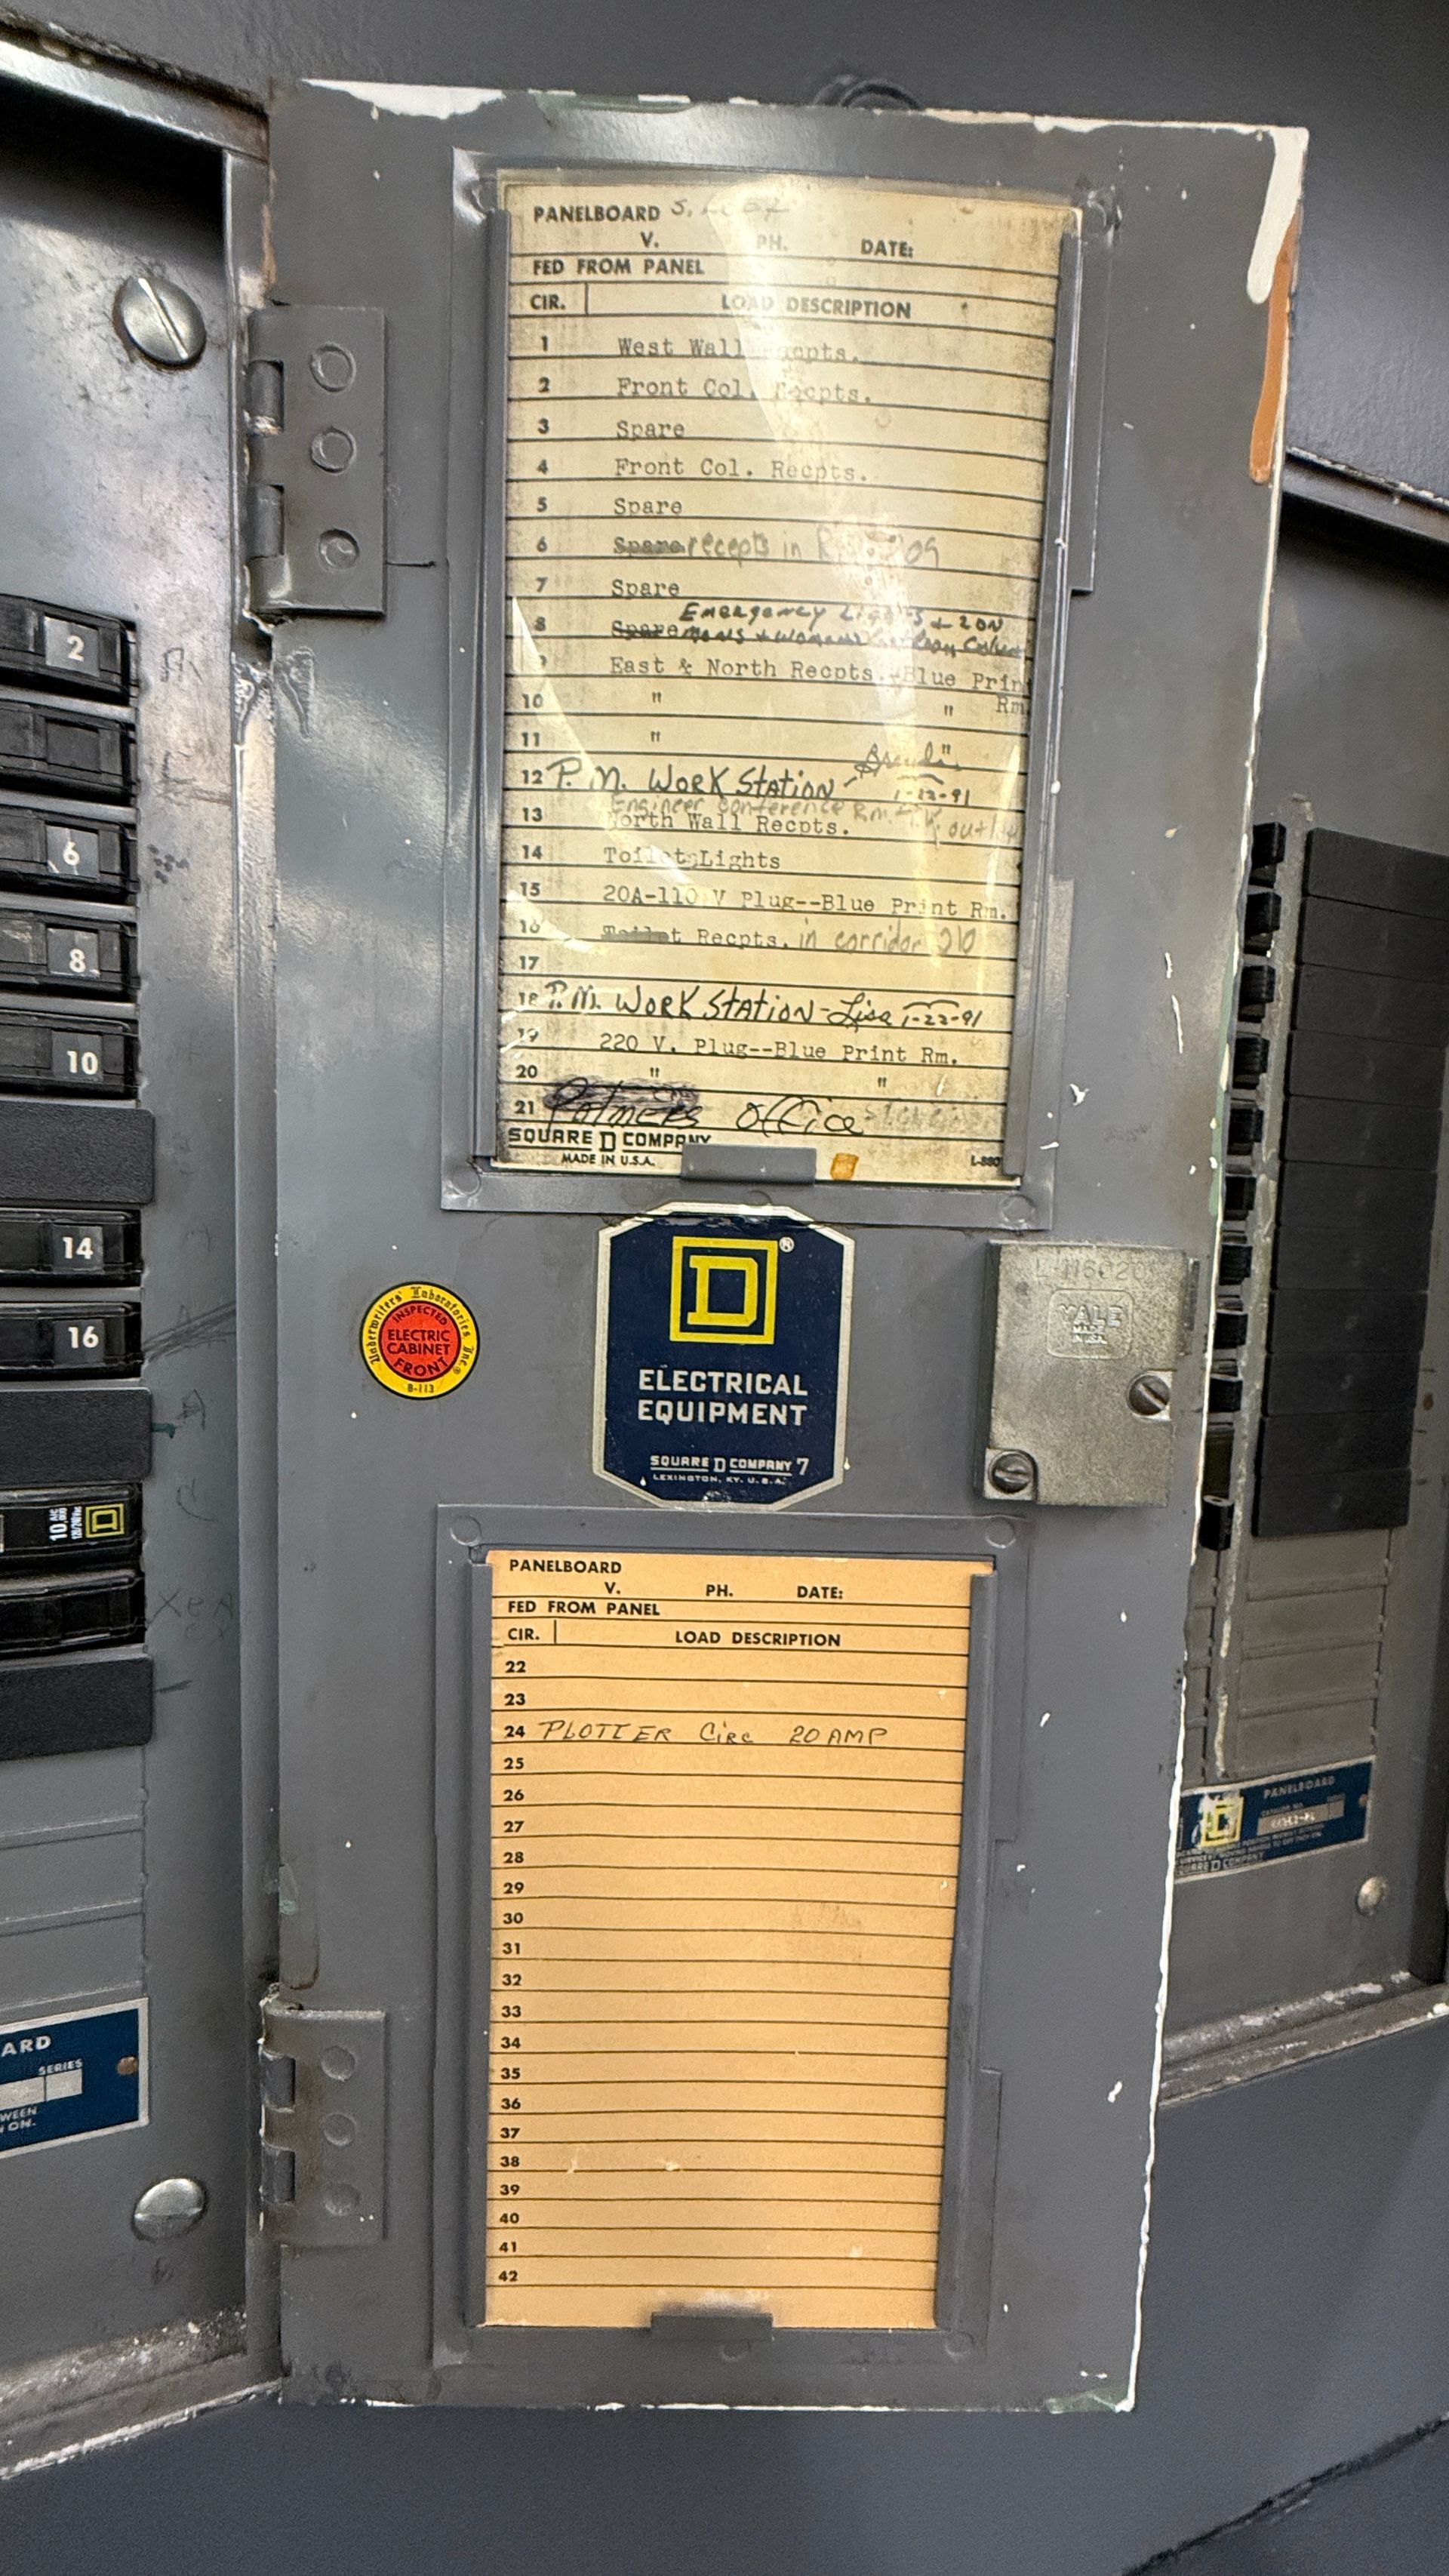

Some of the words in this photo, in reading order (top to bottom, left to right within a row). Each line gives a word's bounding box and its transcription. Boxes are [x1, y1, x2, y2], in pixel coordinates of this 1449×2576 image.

[534, 205, 660, 222] PANELBOARD
[641, 232, 659, 248] V.
[756, 234, 788, 251] PH.
[861, 239, 913, 258] DATE:
[534, 260, 564, 275] FED
[577, 258, 631, 274] FROM
[644, 258, 704, 275] PANEL
[530, 294, 565, 309] CIR.
[721, 294, 774, 310] LOAD
[786, 297, 911, 319] DESCRIPTION
[540, 336, 548, 351] 1
[618, 337, 673, 355] West
[689, 337, 742, 355] Wall
[538, 377, 550, 393] 2
[617, 377, 688, 397] Front
[703, 378, 755, 399] Col.
[538, 419, 549, 434] 3
[617, 420, 685, 441] Spare
[537, 460, 549, 475] 4
[615, 458, 684, 477] Front
[700, 458, 753, 478] Col.
[771, 460, 867, 484] Recpts.
[537, 497, 548, 512] 5
[614, 497, 682, 516] Spare
[537, 537, 547, 552] 6
[536, 577, 548, 593] 7
[612, 579, 681, 598] Spare
[534, 617, 546, 632] 8
[67, 636, 84, 661] 2
[611, 656, 664, 675] East
[680, 657, 692, 675] &
[707, 658, 777, 677] North
[522, 693, 543, 708] 10
[522, 732, 540, 746] 11
[522, 770, 543, 783] 12
[522, 808, 543, 822] 13
[688, 811, 742, 831] Wall
[757, 817, 848, 836] Recpts.
[63, 840, 79, 866] 6
[522, 845, 542, 860] 14
[699, 849, 780, 870] Lights
[521, 882, 540, 897] 15
[891, 897, 958, 916] Print
[971, 901, 1007, 920] Rm.
[697, 929, 788, 949] Recpts.
[69, 948, 86, 973] 8
[519, 956, 539, 970] 17
[601, 1033, 638, 1051] 220
[654, 1035, 675, 1053] V.
[843, 1045, 906, 1063] Print
[921, 1046, 958, 1065] Rm.
[68, 1051, 98, 1076] 10
[515, 1066, 537, 1079] 20
[515, 1101, 534, 1115] 21
[509, 1128, 592, 1144] SQUARE
[600, 1132, 616, 1153] D
[561, 1153, 595, 1165] MADE
[601, 1155, 614, 1165] IN
[620, 1156, 656, 1166] U.S.A.
[63, 1237, 94, 1259] 14
[392, 1305, 448, 1326] INSPECTED
[68, 1326, 99, 1349] 16
[387, 1329, 451, 1341] ELECTRIC
[386, 1343, 451, 1355] CABINET
[393, 1357, 449, 1377] FRONT
[639, 1368, 808, 1396] ELECTRICAL
[637, 1399, 808, 1426] EQUIPMENT
[650, 1454, 709, 1468] SQUARE
[714, 1457, 726, 1473] D
[730, 1457, 792, 1471] COMPANY
[796, 1457, 809, 1476] 7
[653, 1473, 721, 1484] LEXINGTON,
[509, 1559, 622, 1574] PANELBOARD
[605, 1581, 621, 1594] V.
[706, 1584, 734, 1597] PH.
[797, 1586, 844, 1599] DATE:
[508, 1601, 536, 1614] FED
[548, 1601, 595, 1614] FROM
[607, 1602, 660, 1616] PANEL
[508, 1627, 540, 1640] CIR.
[675, 1630, 721, 1644] LOAD
[732, 1631, 841, 1646] DESCRIPTION
[505, 1660, 526, 1673] 22
[504, 1693, 526, 1706] 23
[504, 1725, 525, 1737] 24
[789, 1725, 820, 1743] 20
[828, 1727, 888, 1745] AMP
[503, 1757, 525, 1770] 25
[503, 1789, 525, 1802] 26
[503, 1820, 525, 1833] 27
[503, 1851, 525, 1864] 28
[503, 1882, 525, 1894] 29
[503, 1913, 524, 1924] 30
[502, 1942, 521, 1955] 31
[502, 1974, 522, 1986] 32
[501, 2005, 521, 2017] 33
[501, 2037, 521, 2049] 34
[38, 2058, 84, 2076] SERIES
[500, 2067, 521, 2079] 35
[501, 2097, 521, 2110] 36
[500, 2128, 521, 2139] 37
[500, 2156, 520, 2167] 38
[500, 2184, 520, 2196] 39
[500, 2213, 519, 2224] 40
[499, 2242, 517, 2252] 41
[498, 2270, 518, 2282] 42
